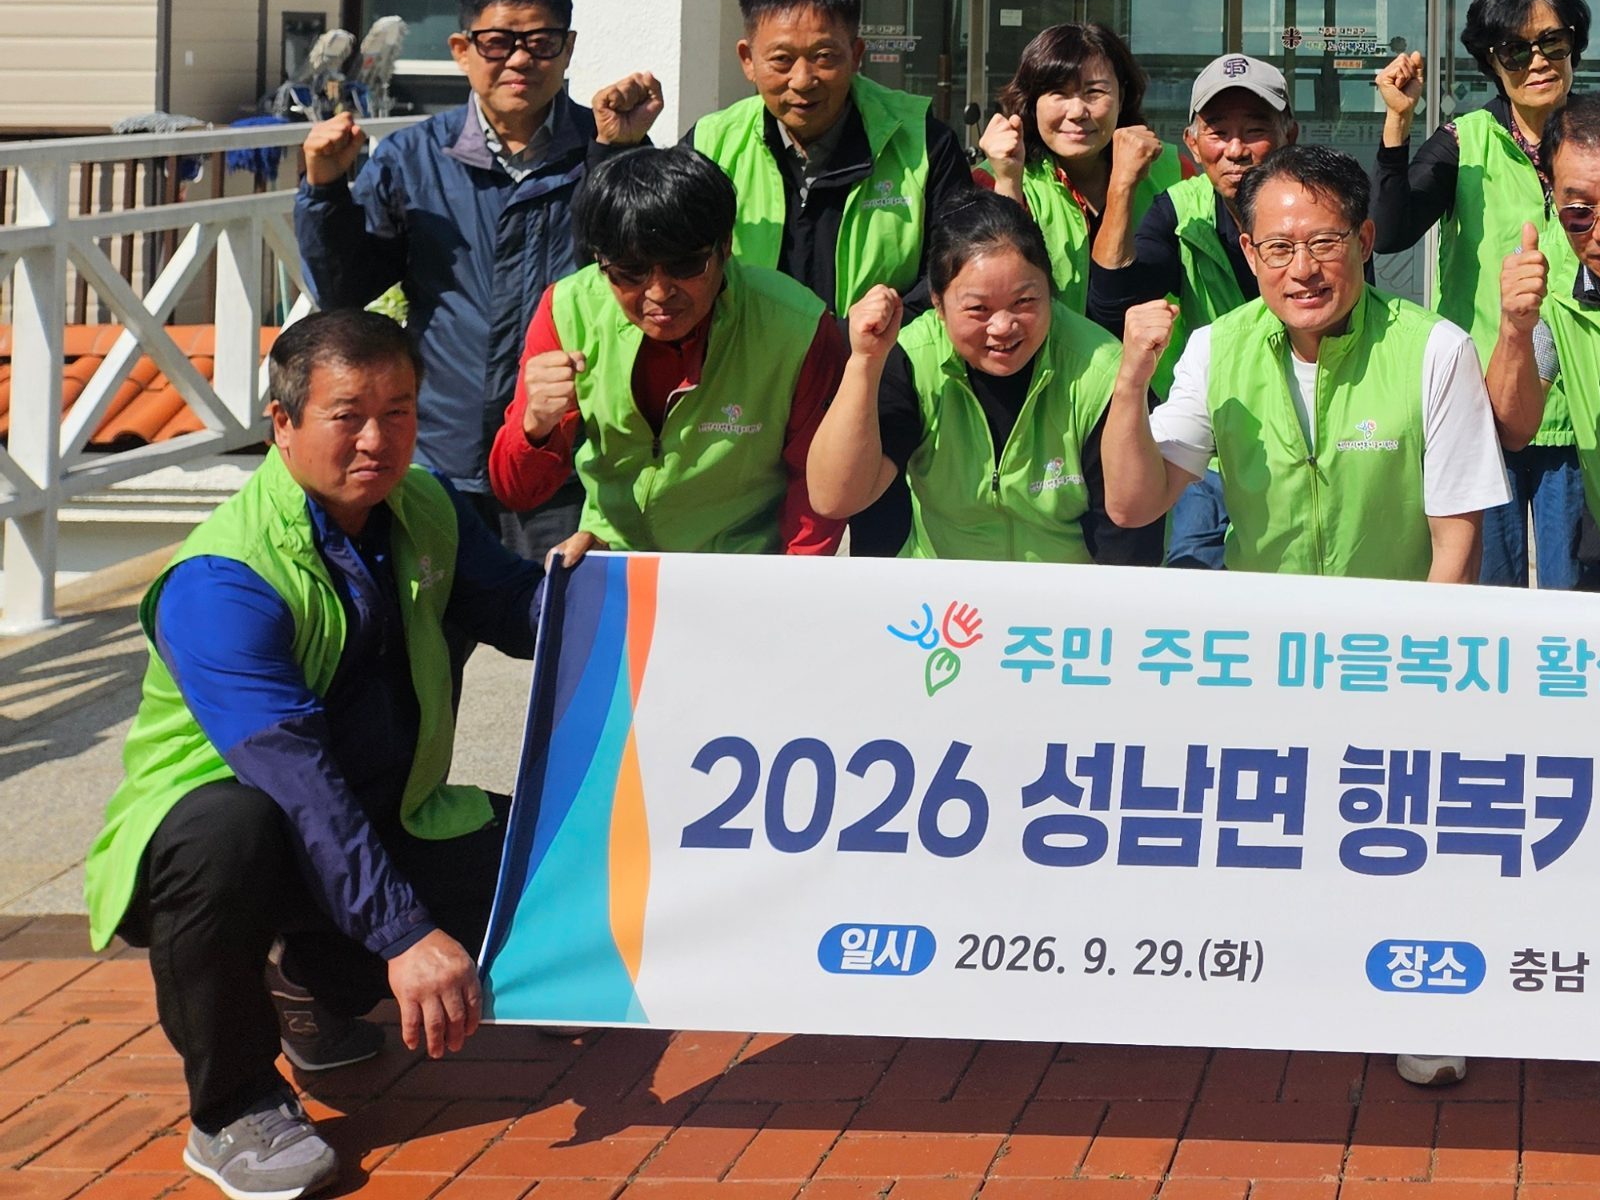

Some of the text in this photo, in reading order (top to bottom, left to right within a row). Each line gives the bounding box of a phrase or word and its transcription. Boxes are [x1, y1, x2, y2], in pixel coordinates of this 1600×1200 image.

[1000, 626, 1112, 685] 주민
[1137, 629, 1253, 687] 주도
[1278, 632, 1509, 693] 마을복지
[680, 736, 989, 857] 2026
[1021, 742, 1308, 868] 성남면
[840, 927, 1264, 982] 일시 2026. 9. 29.(화)
[1386, 945, 1467, 988] 장소
[1509, 948, 1589, 993] 충남
